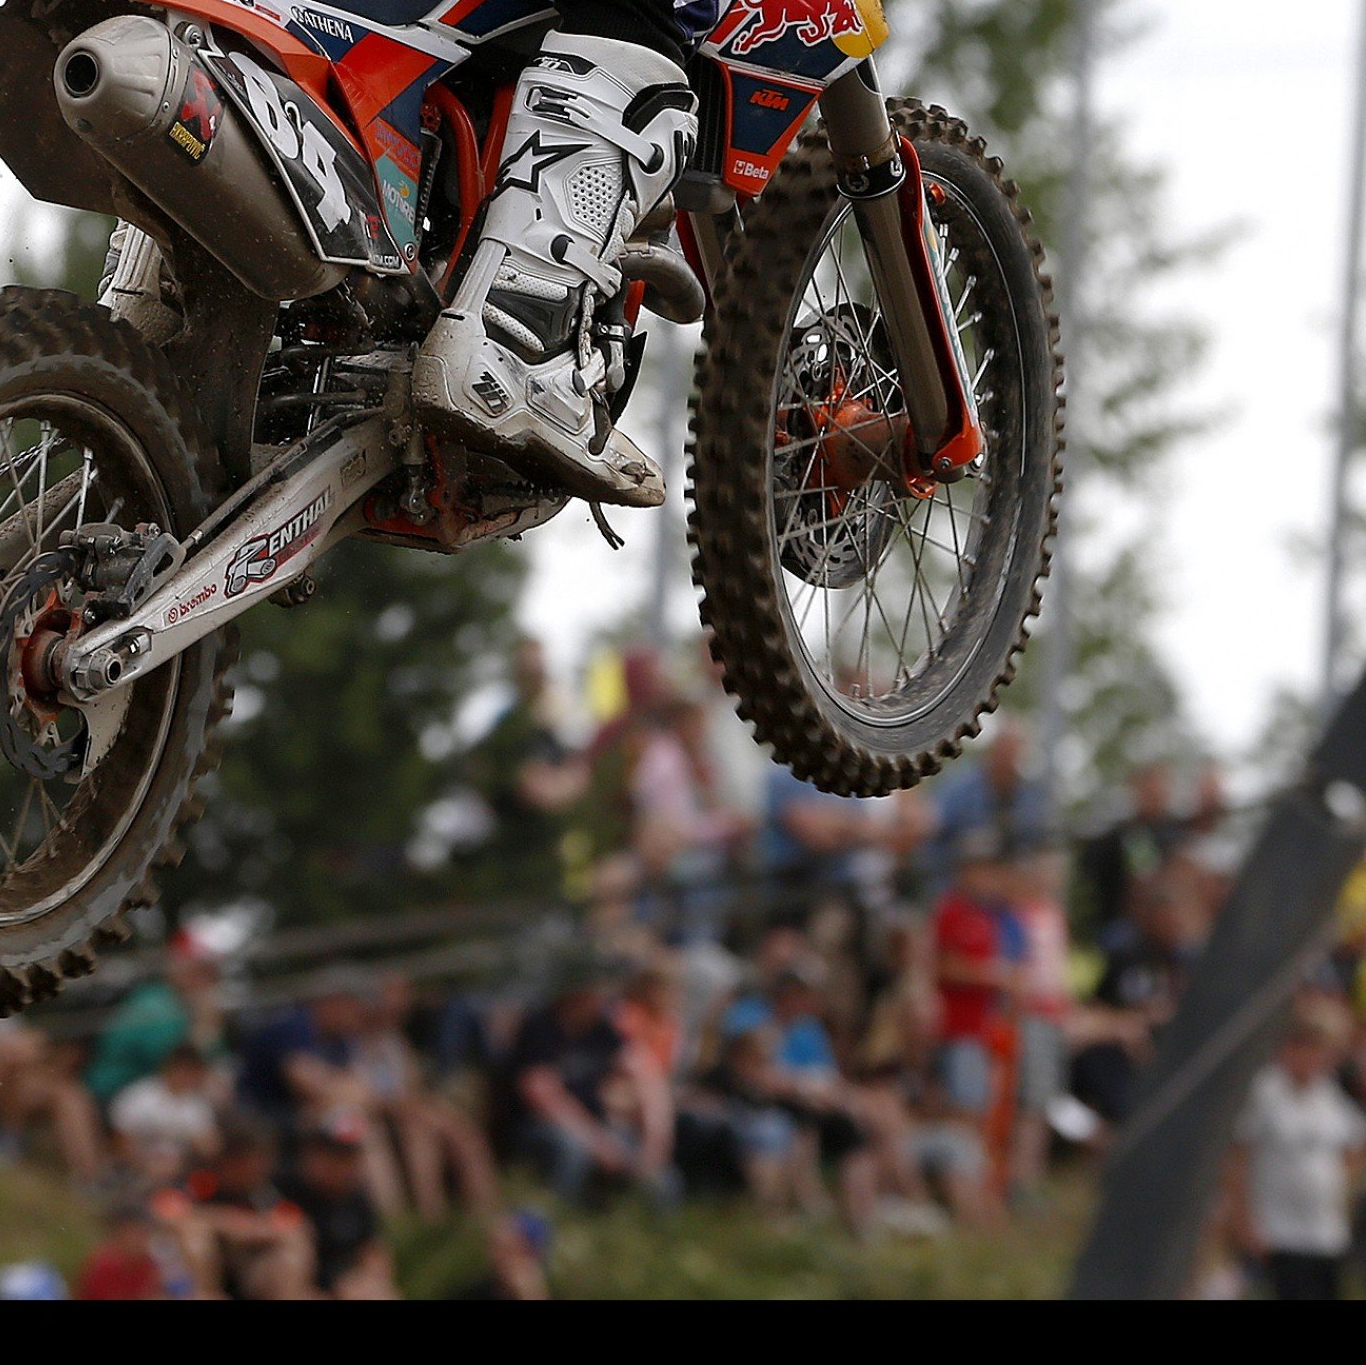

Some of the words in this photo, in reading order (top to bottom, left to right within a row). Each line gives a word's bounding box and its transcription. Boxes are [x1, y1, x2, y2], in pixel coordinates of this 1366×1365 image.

[304, 11, 355, 44] ATHENA
[749, 88, 790, 111] KTM
[228, 51, 352, 233] 84
[743, 162, 770, 180] Beta
[179, 583, 217, 616] brembo
